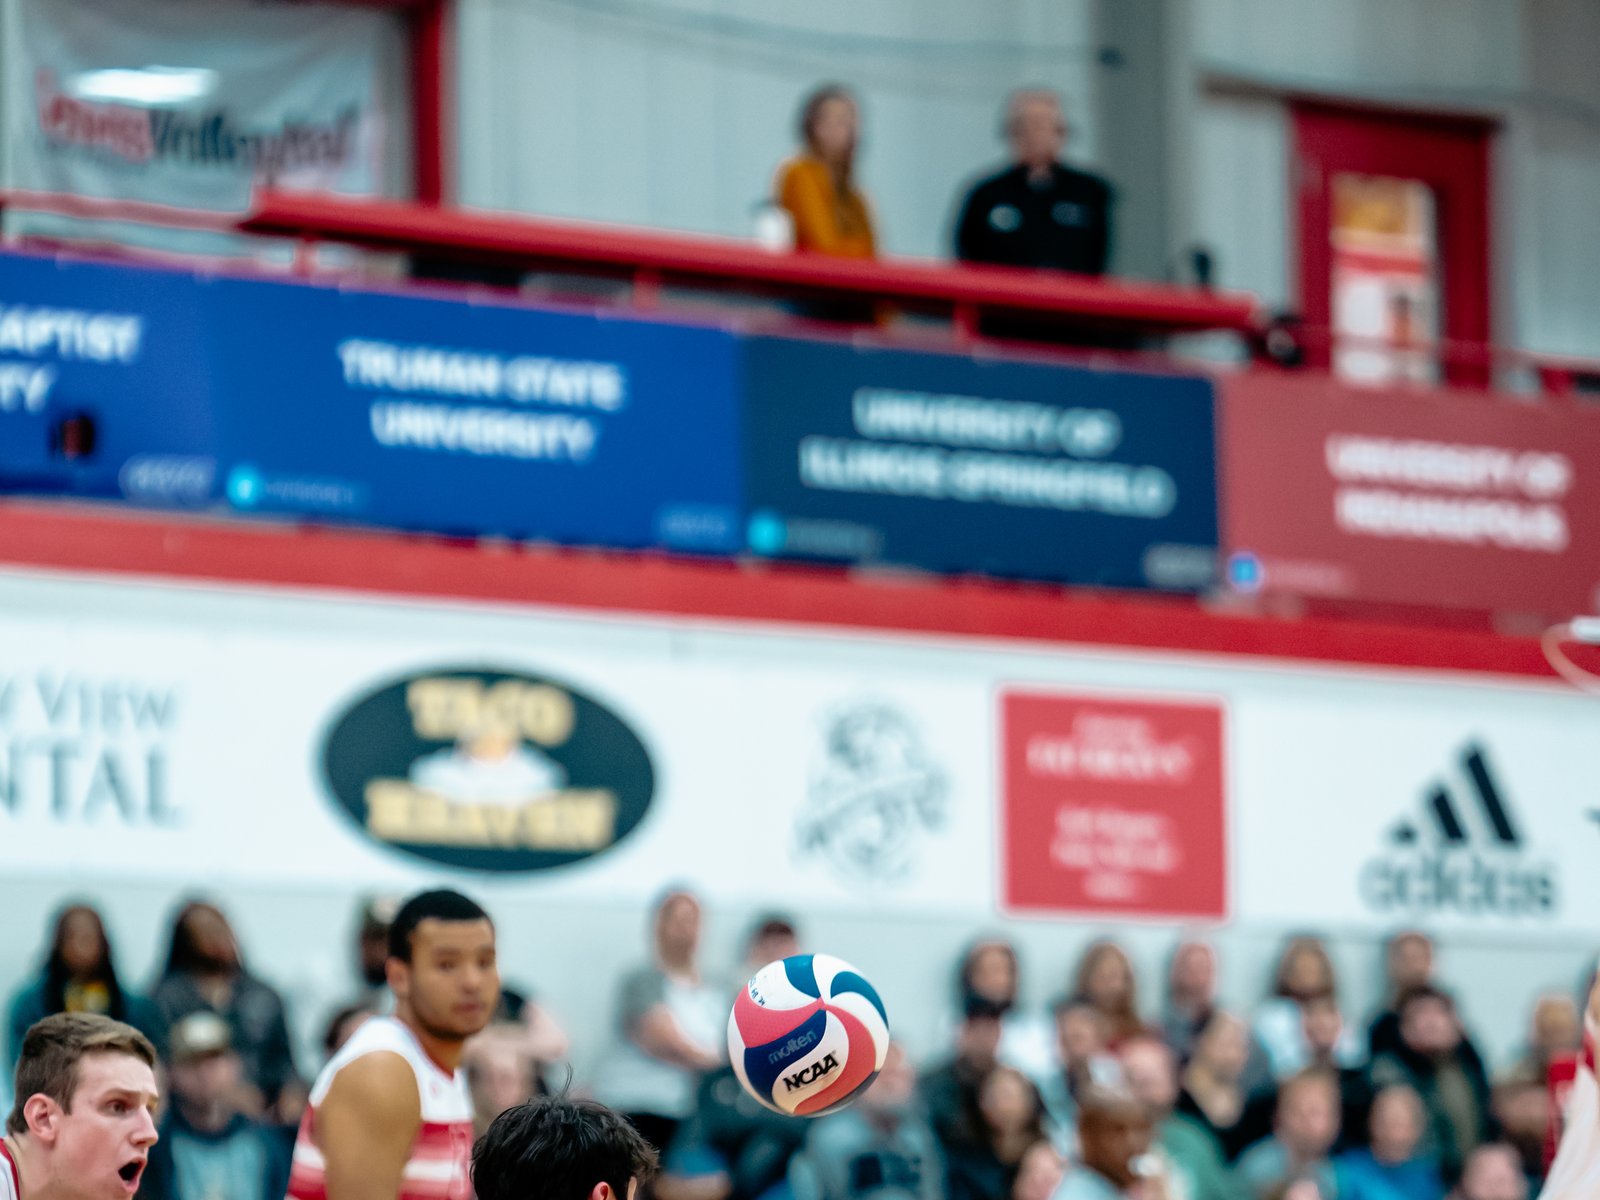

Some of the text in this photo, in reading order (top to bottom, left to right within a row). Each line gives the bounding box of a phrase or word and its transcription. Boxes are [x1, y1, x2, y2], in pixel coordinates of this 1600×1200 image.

[338, 338, 626, 411] TRUMAN STATE
[370, 399, 597, 462] UNIVERSITY
[853, 387, 1058, 452] UNIVERSITY
[408, 678, 573, 745] TACO
[1360, 850, 1558, 916] adidas
[767, 1030, 818, 1065] molten
[783, 1053, 839, 1092] NCAA
